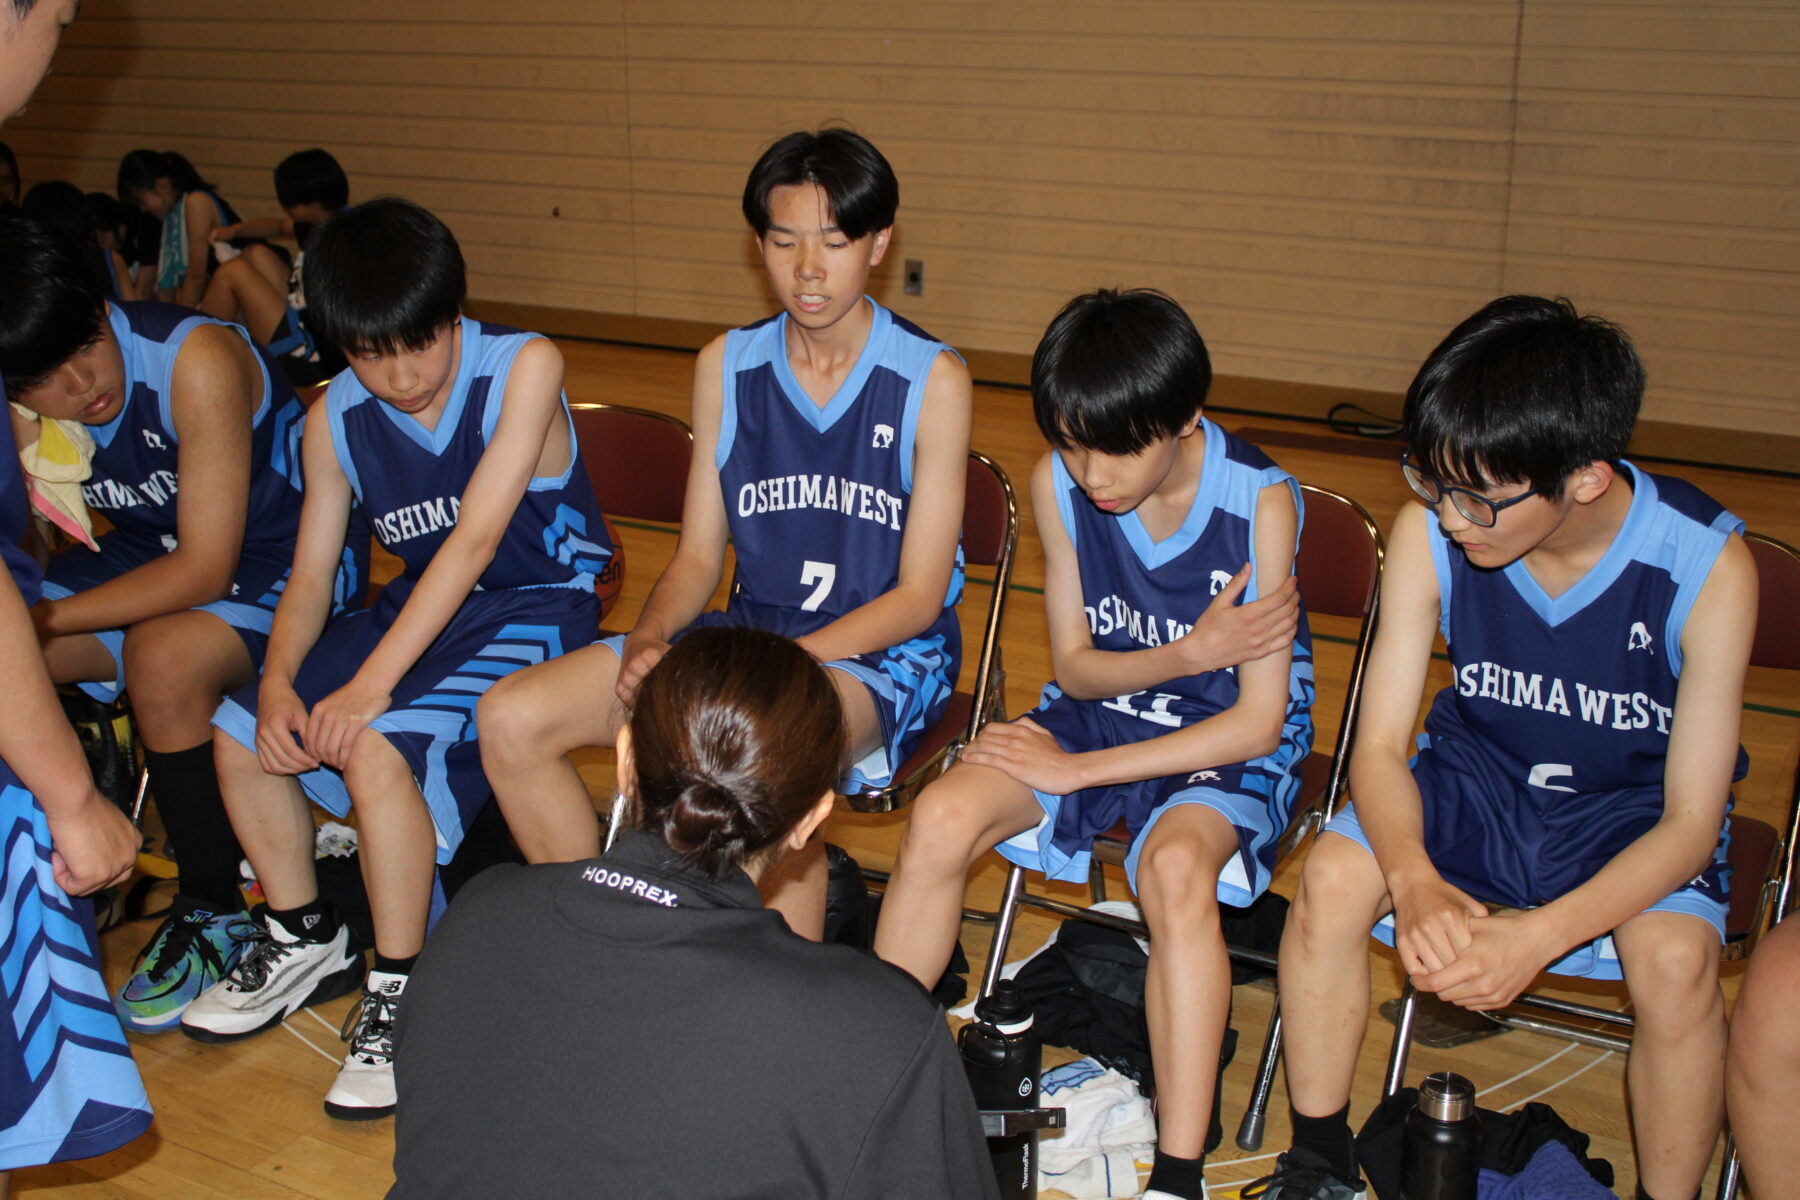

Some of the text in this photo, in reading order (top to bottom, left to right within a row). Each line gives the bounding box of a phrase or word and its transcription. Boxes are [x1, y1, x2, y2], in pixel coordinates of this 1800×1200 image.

[738, 474, 902, 531] OSHIMA WEST
[800, 560, 836, 612] 7
[1452, 661, 1673, 735] SHIMA WEST
